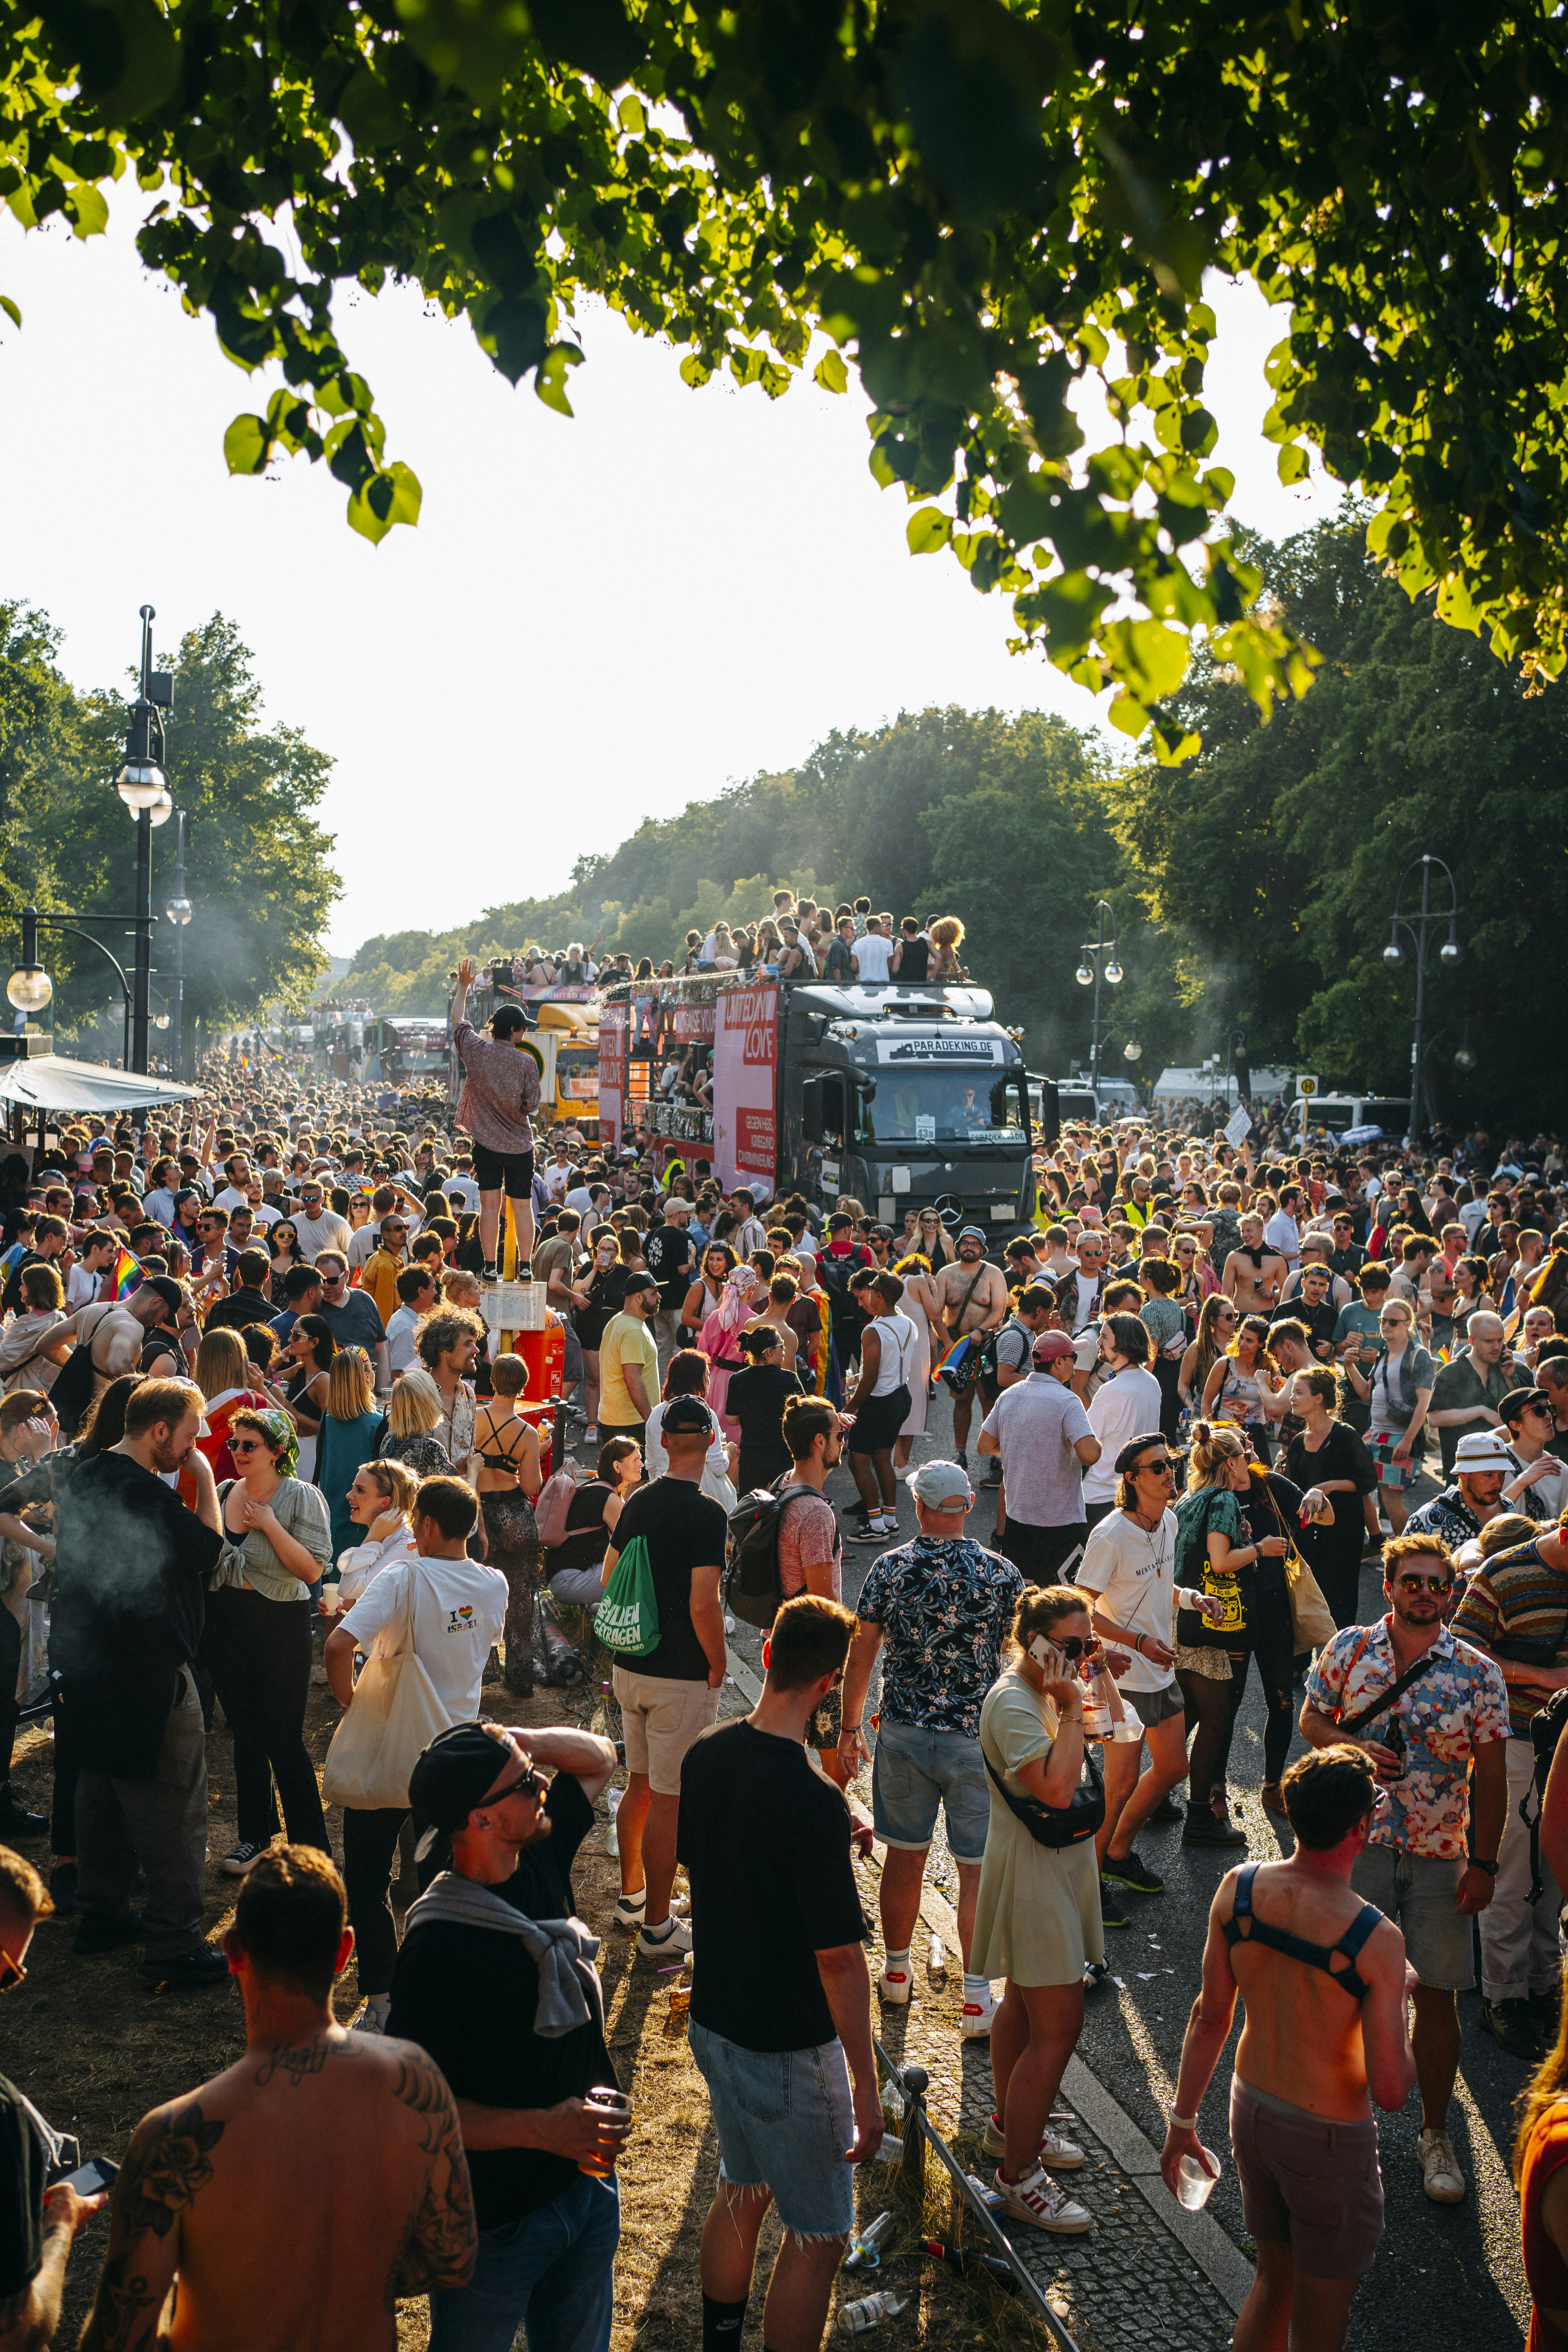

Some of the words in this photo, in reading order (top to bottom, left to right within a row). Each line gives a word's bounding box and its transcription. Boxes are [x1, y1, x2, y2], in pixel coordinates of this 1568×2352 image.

[746, 1028, 773, 1058] LOVE
[914, 1041, 993, 1051] PARADEKING.DE
[918, 1129, 933, 1138] 43a
[1136, 1563, 1156, 1577] MENTA
[1212, 1588, 1231, 1596] SEGAR
[597, 1595, 612, 1619] VON
[450, 1610, 458, 1623] I
[447, 1619, 479, 1634] ISRAEL
[594, 1619, 641, 1646] GETRAGEN
